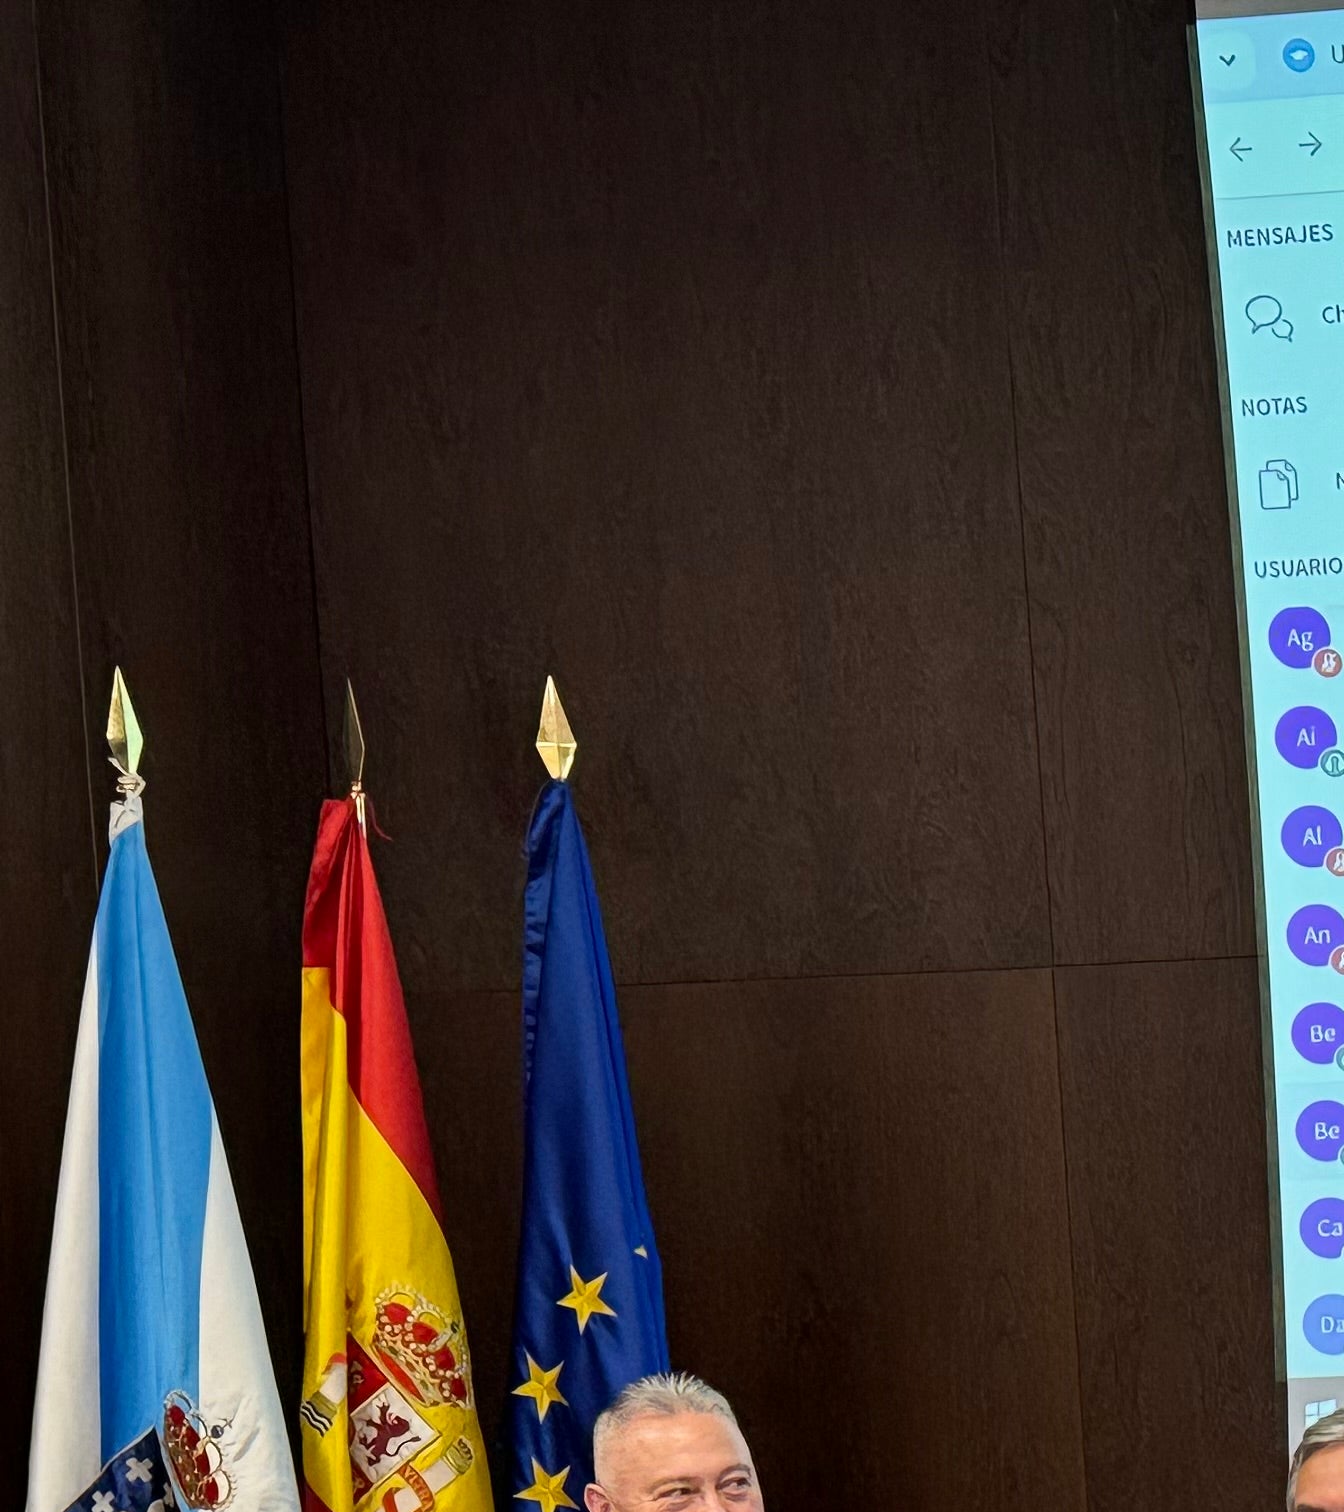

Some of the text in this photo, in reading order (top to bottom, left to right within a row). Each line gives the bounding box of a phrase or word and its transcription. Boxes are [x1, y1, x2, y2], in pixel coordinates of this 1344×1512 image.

[1227, 223, 1334, 247] MENSAJES
[1241, 396, 1308, 417] NOTAS
[1287, 628, 1314, 652] Ag
[1296, 726, 1316, 747] Ai
[1304, 926, 1331, 944] An
[1310, 1025, 1336, 1043] Be
[1314, 1122, 1340, 1140] Be
[1317, 1219, 1343, 1237] Ca
